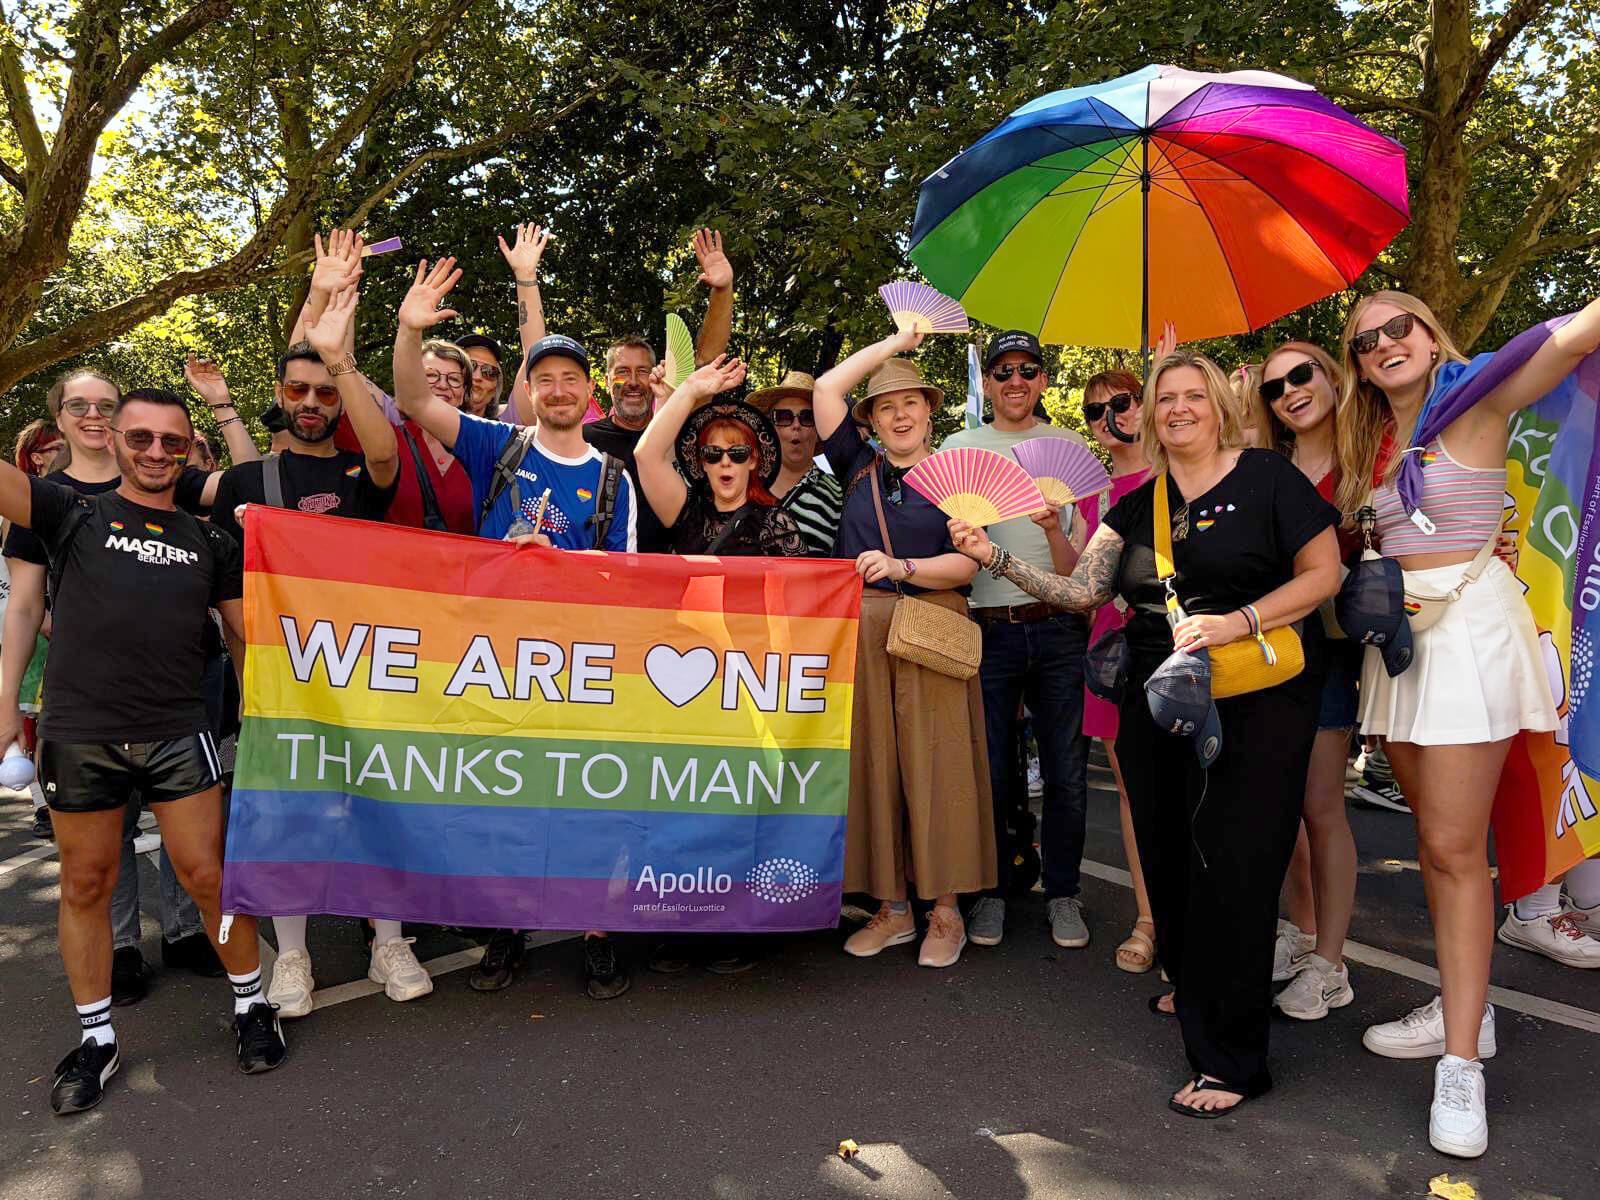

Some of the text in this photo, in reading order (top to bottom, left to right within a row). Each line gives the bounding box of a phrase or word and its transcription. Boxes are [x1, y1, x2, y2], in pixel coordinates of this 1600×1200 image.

[515, 468, 537, 482] JAKO
[1588, 500, 1597, 514] of
[137, 553, 171, 566] BERLIN
[279, 614, 421, 694] WE
[443, 634, 616, 705] ARE
[276, 733, 822, 806] THANKS TO MANY
[634, 865, 733, 899] Apollo
[633, 903, 726, 912] part of EssilorLuxottica
